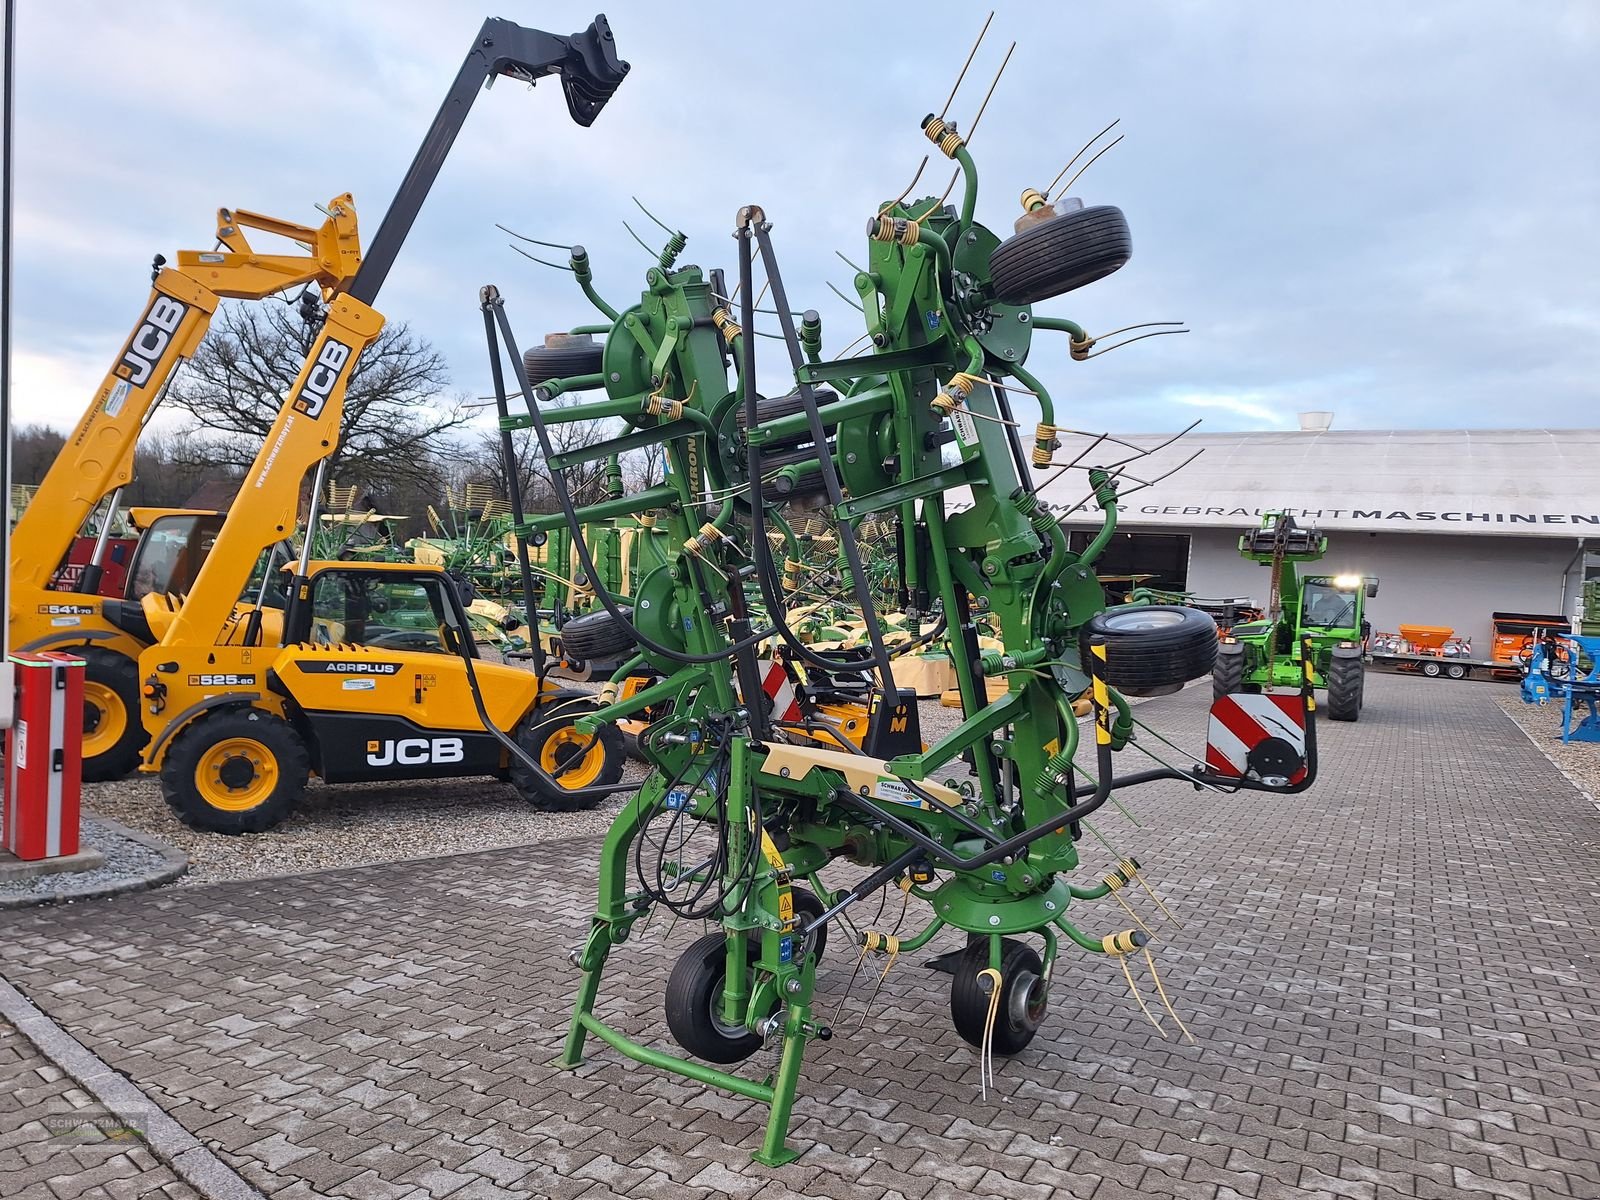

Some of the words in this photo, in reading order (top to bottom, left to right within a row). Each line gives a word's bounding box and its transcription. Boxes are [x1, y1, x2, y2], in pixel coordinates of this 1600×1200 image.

[124, 296, 185, 384] JCB
[301, 340, 349, 417] JCB
[255, 415, 296, 489] www.schwarzmayr.at
[326, 663, 395, 673] AGRIPLUS
[366, 737, 464, 766] JCB
